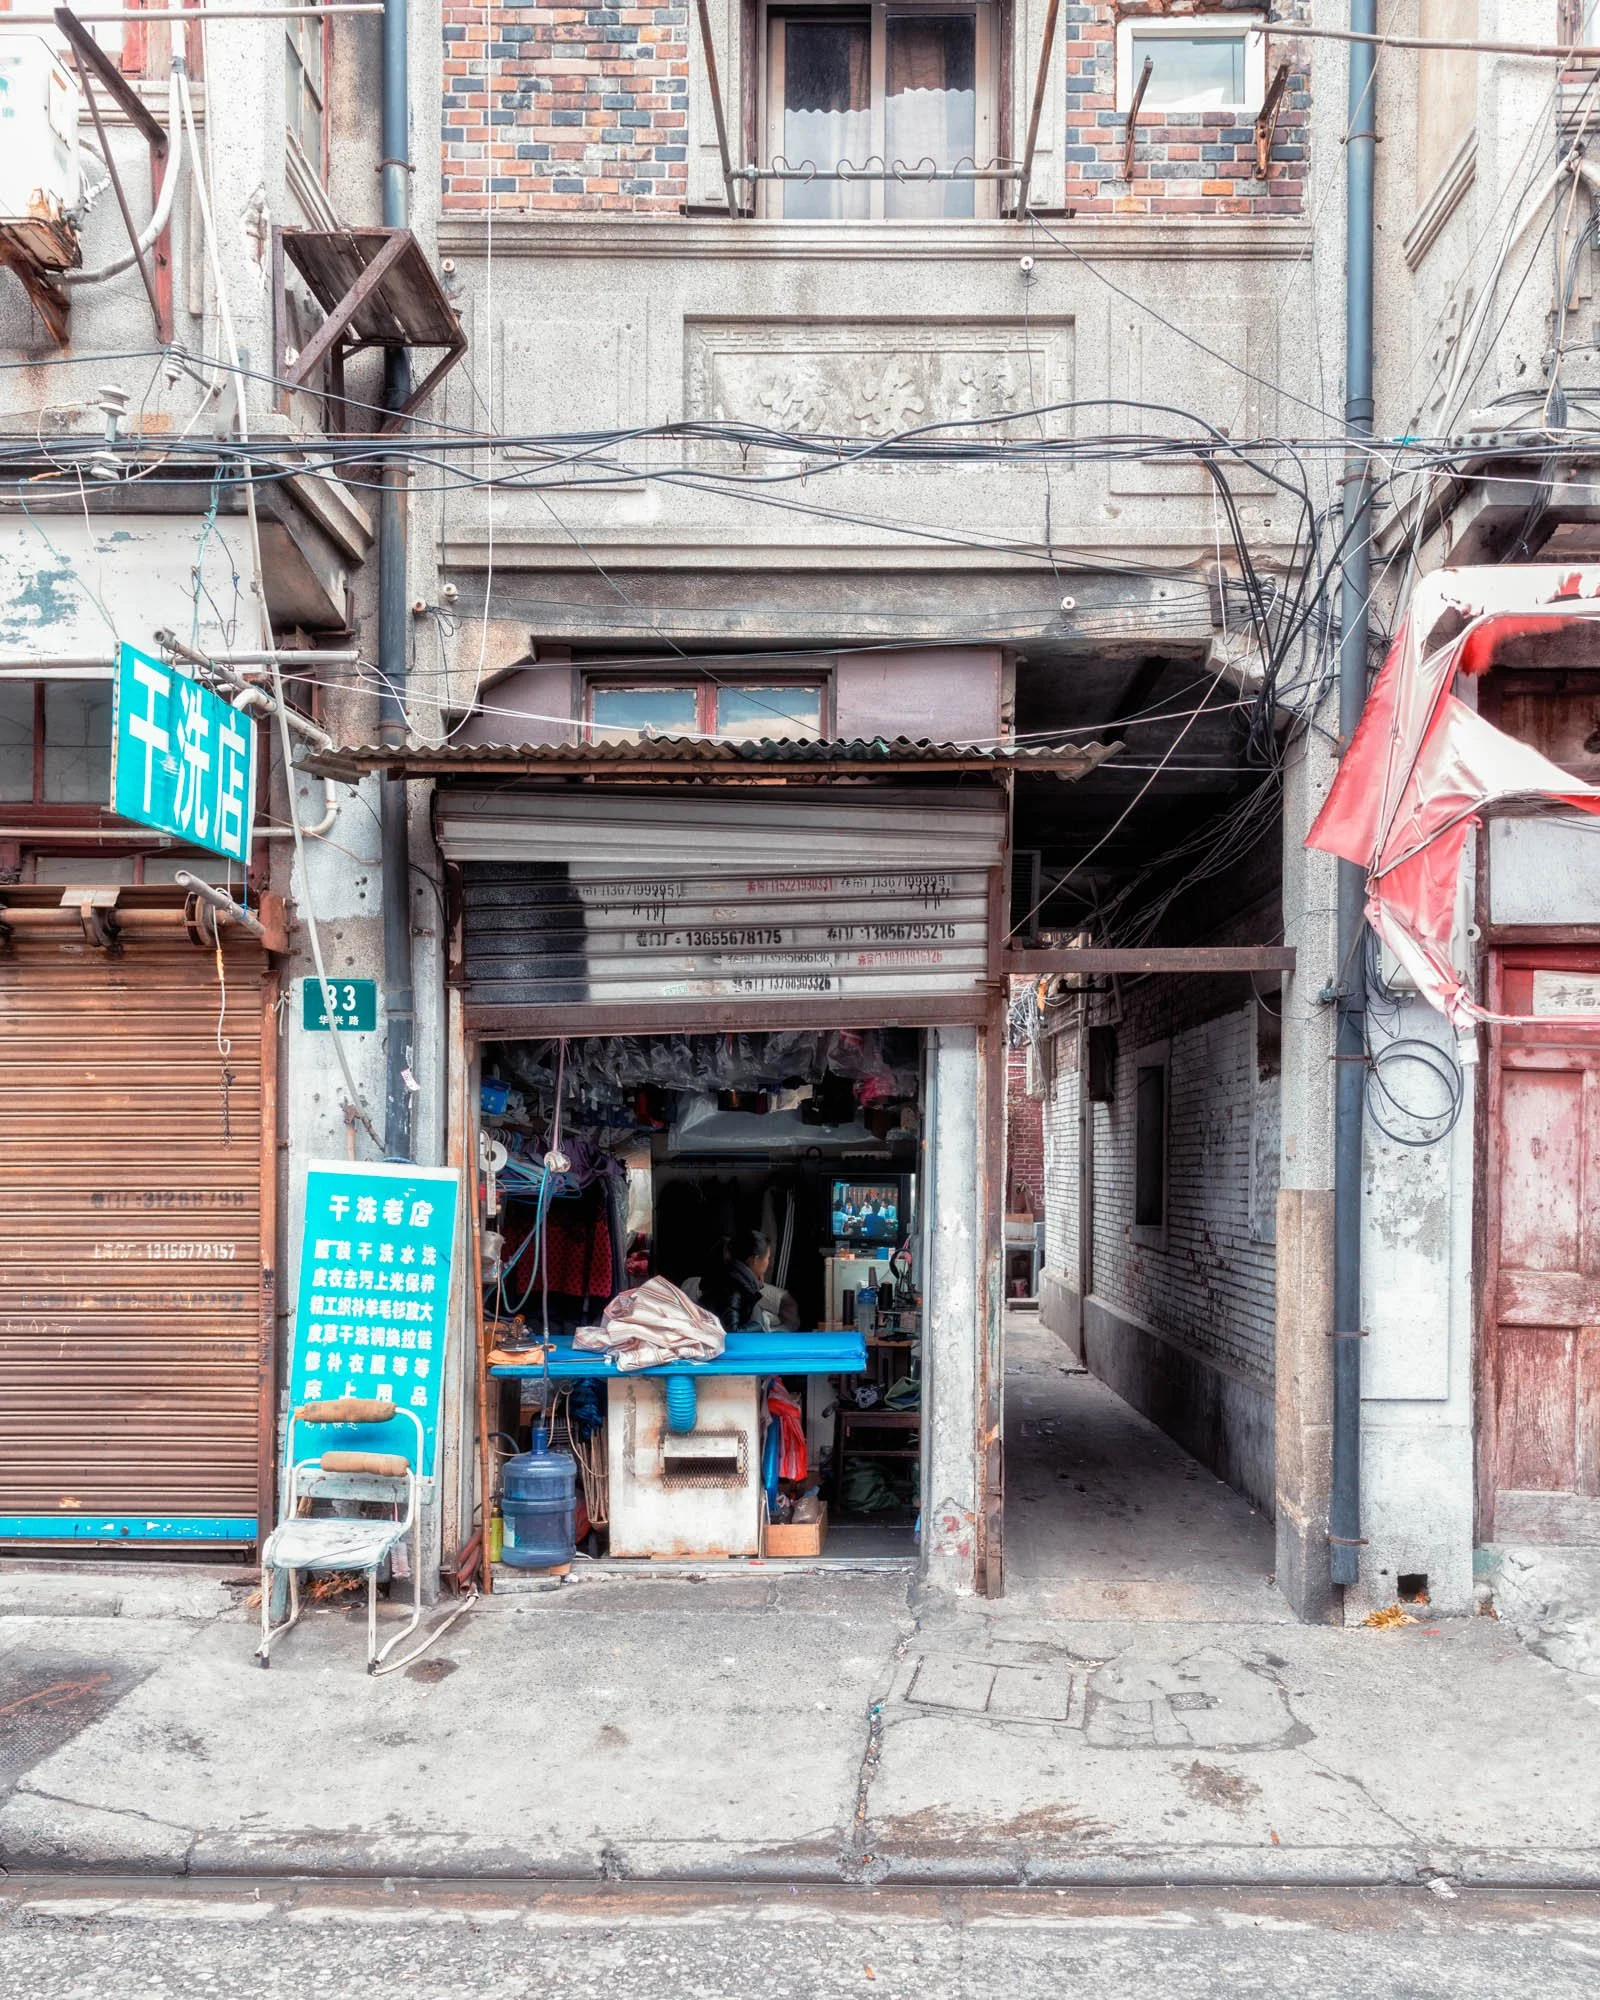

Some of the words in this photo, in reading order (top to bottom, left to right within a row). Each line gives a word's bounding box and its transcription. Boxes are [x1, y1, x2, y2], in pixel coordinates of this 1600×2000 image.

[128, 657, 246, 858] 干洗店
[329, 1194, 434, 1228] 干洗老店
[314, 1238, 437, 1267] 服装干洗水洗
[311, 1267, 436, 1294] 皮衣去污上光保养
[303, 1379, 428, 1407] 床上用品
